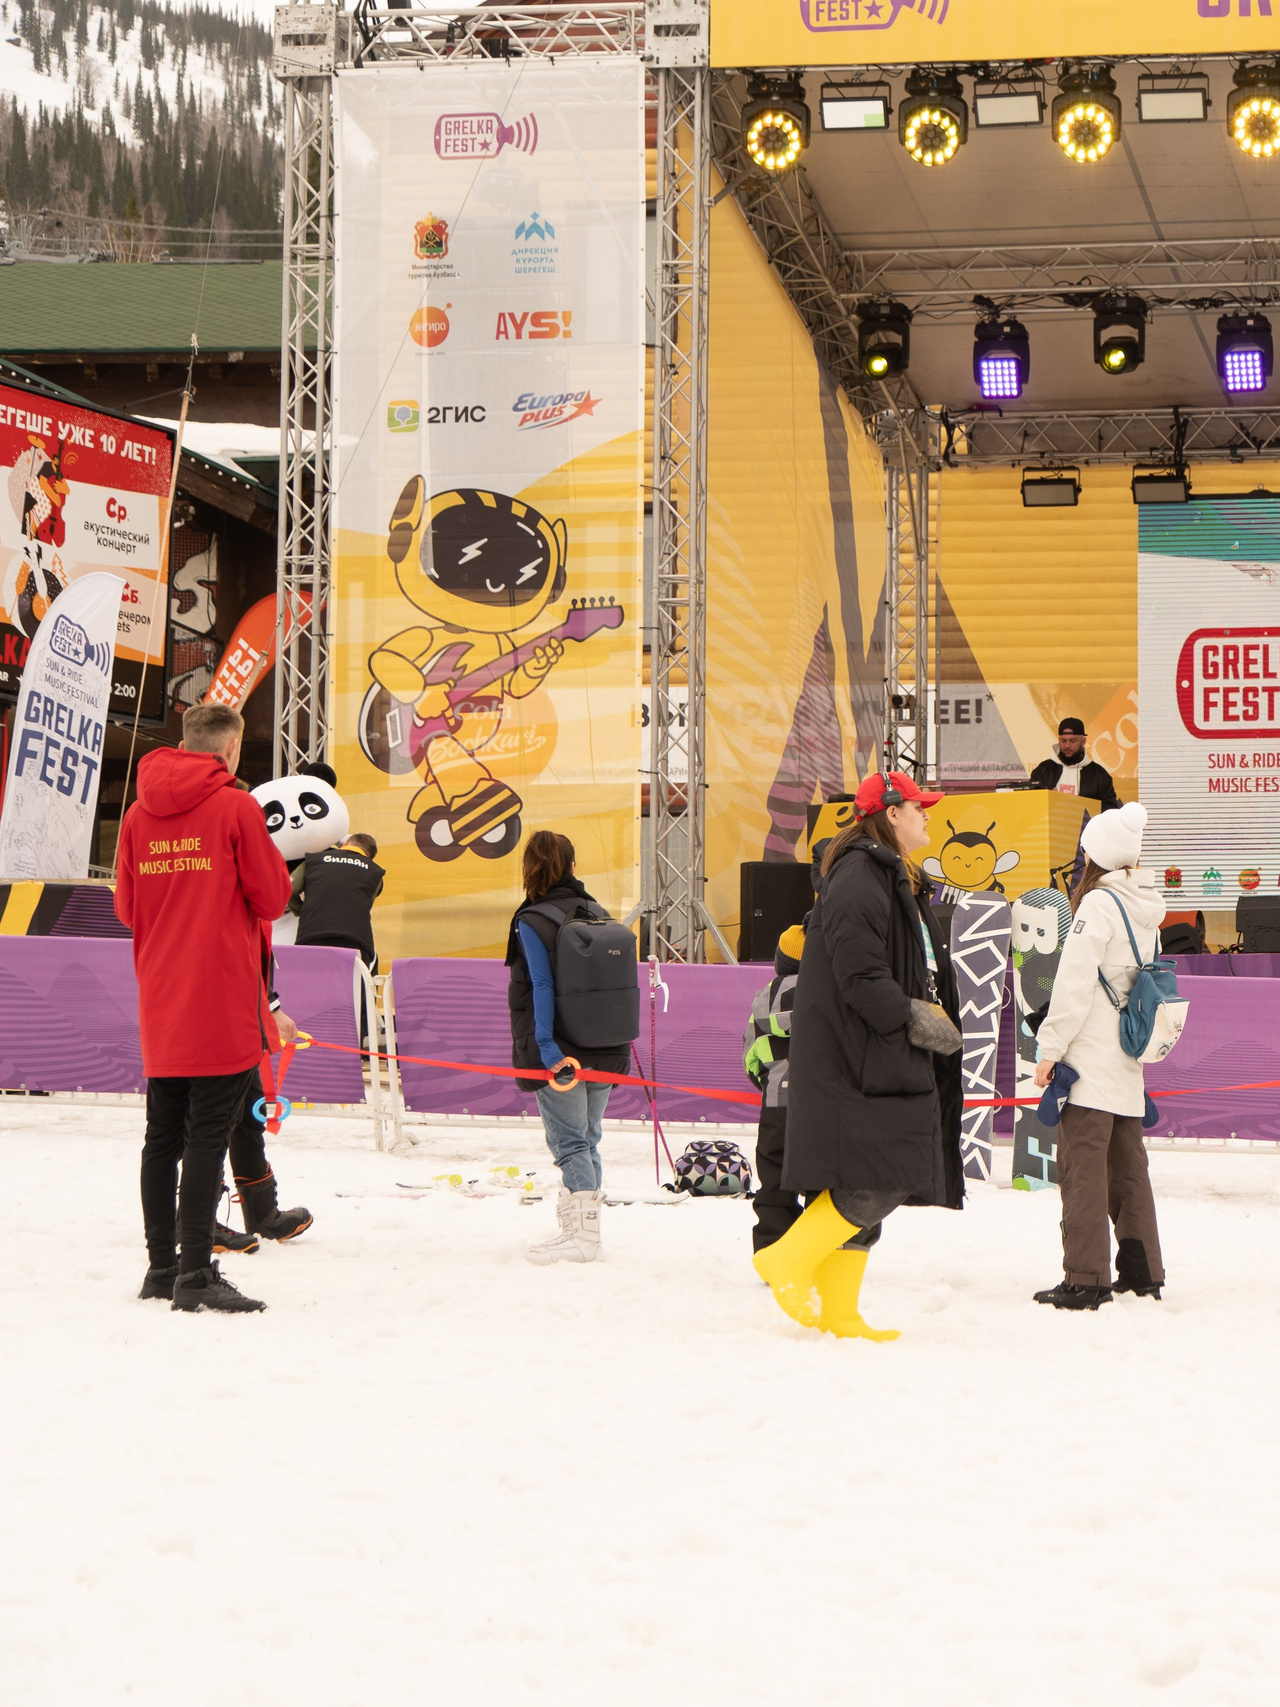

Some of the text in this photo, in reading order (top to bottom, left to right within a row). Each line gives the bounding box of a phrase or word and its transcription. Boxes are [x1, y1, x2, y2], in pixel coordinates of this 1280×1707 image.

[815, 0, 862, 22] FEST
[444, 119, 493, 135] GRELKA
[444, 137, 477, 153] FEST
[511, 247, 558, 256] ДИРЕКЦИЯ
[515, 266, 555, 274] ШЕРЕГЕШ
[413, 322, 447, 336] энгиро
[495, 310, 572, 340] AYS!
[427, 405, 487, 424] 2ГИС
[58, 420, 95, 449] УЖЕ
[100, 433, 116, 455] 10
[120, 440, 157, 466] ЛЕТ!
[83, 520, 150, 546] акустический
[96, 536, 137, 555] концерт
[118, 610, 151, 626] ечером
[53, 635, 72, 654] FEST
[45, 657, 60, 672] SUN
[66, 668, 83, 685] RIDE
[44, 673, 99, 709] MUSIC FESTIVAL
[1203, 686, 1280, 722] FEST
[24, 689, 104, 756] GRELKA
[14, 728, 98, 806] FEST
[1208, 753, 1236, 769] SUN
[1239, 754, 1249, 768] &
[1208, 777, 1252, 793] MUSIC
[149, 840, 171, 855] SUN
[172, 840, 180, 852] &
[139, 859, 174, 876] MUSIC
[323, 855, 369, 870] билайн
